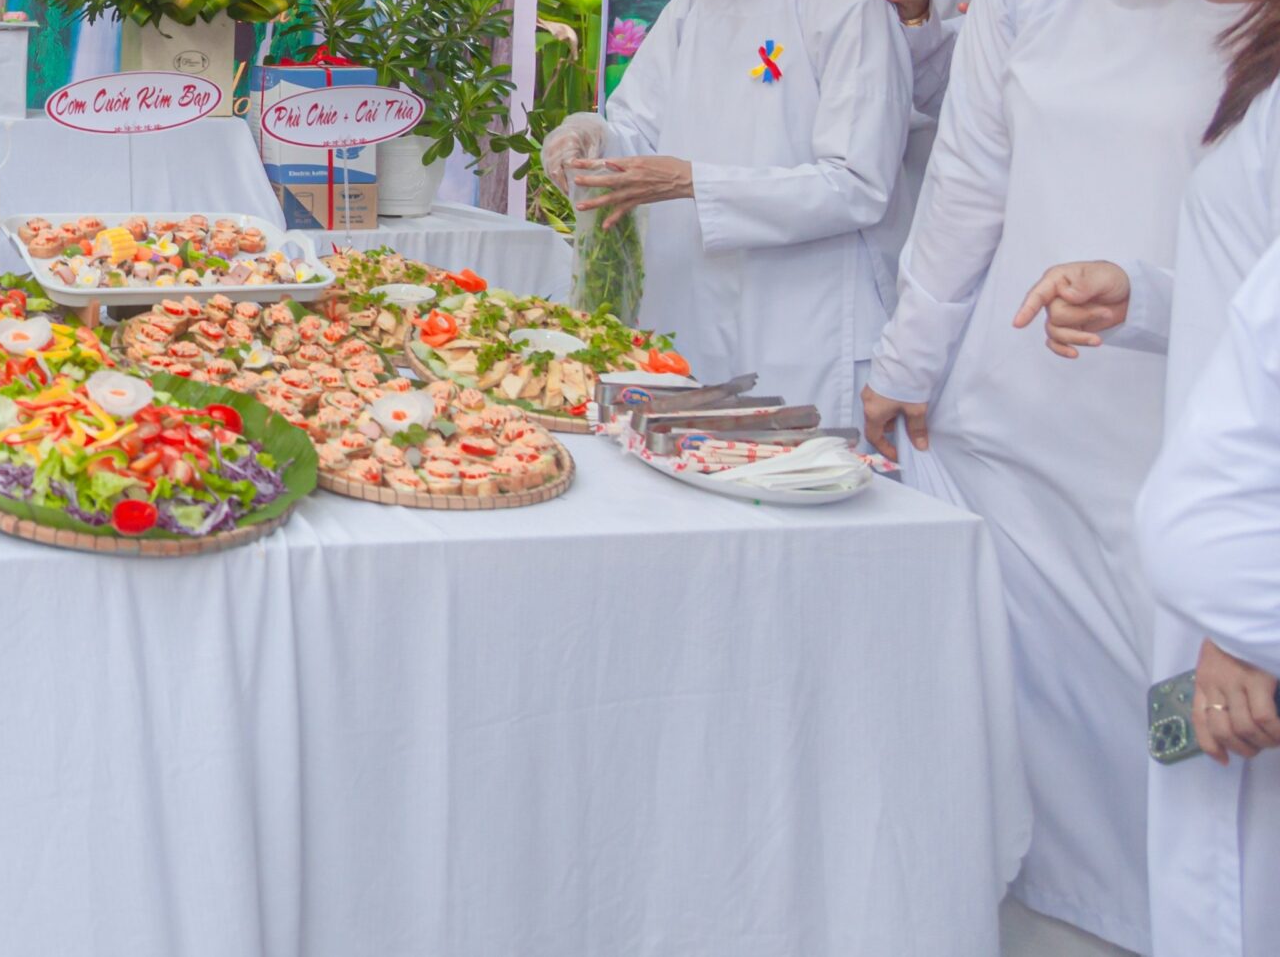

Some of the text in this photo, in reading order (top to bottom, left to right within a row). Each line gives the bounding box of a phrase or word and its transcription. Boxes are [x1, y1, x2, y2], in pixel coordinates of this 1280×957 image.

[55, 90, 87, 116] Cơm
[137, 86, 172, 112] Kim
[274, 105, 300, 128] Phù
[355, 99, 381, 123] Cải
[385, 99, 414, 122] Thìa
